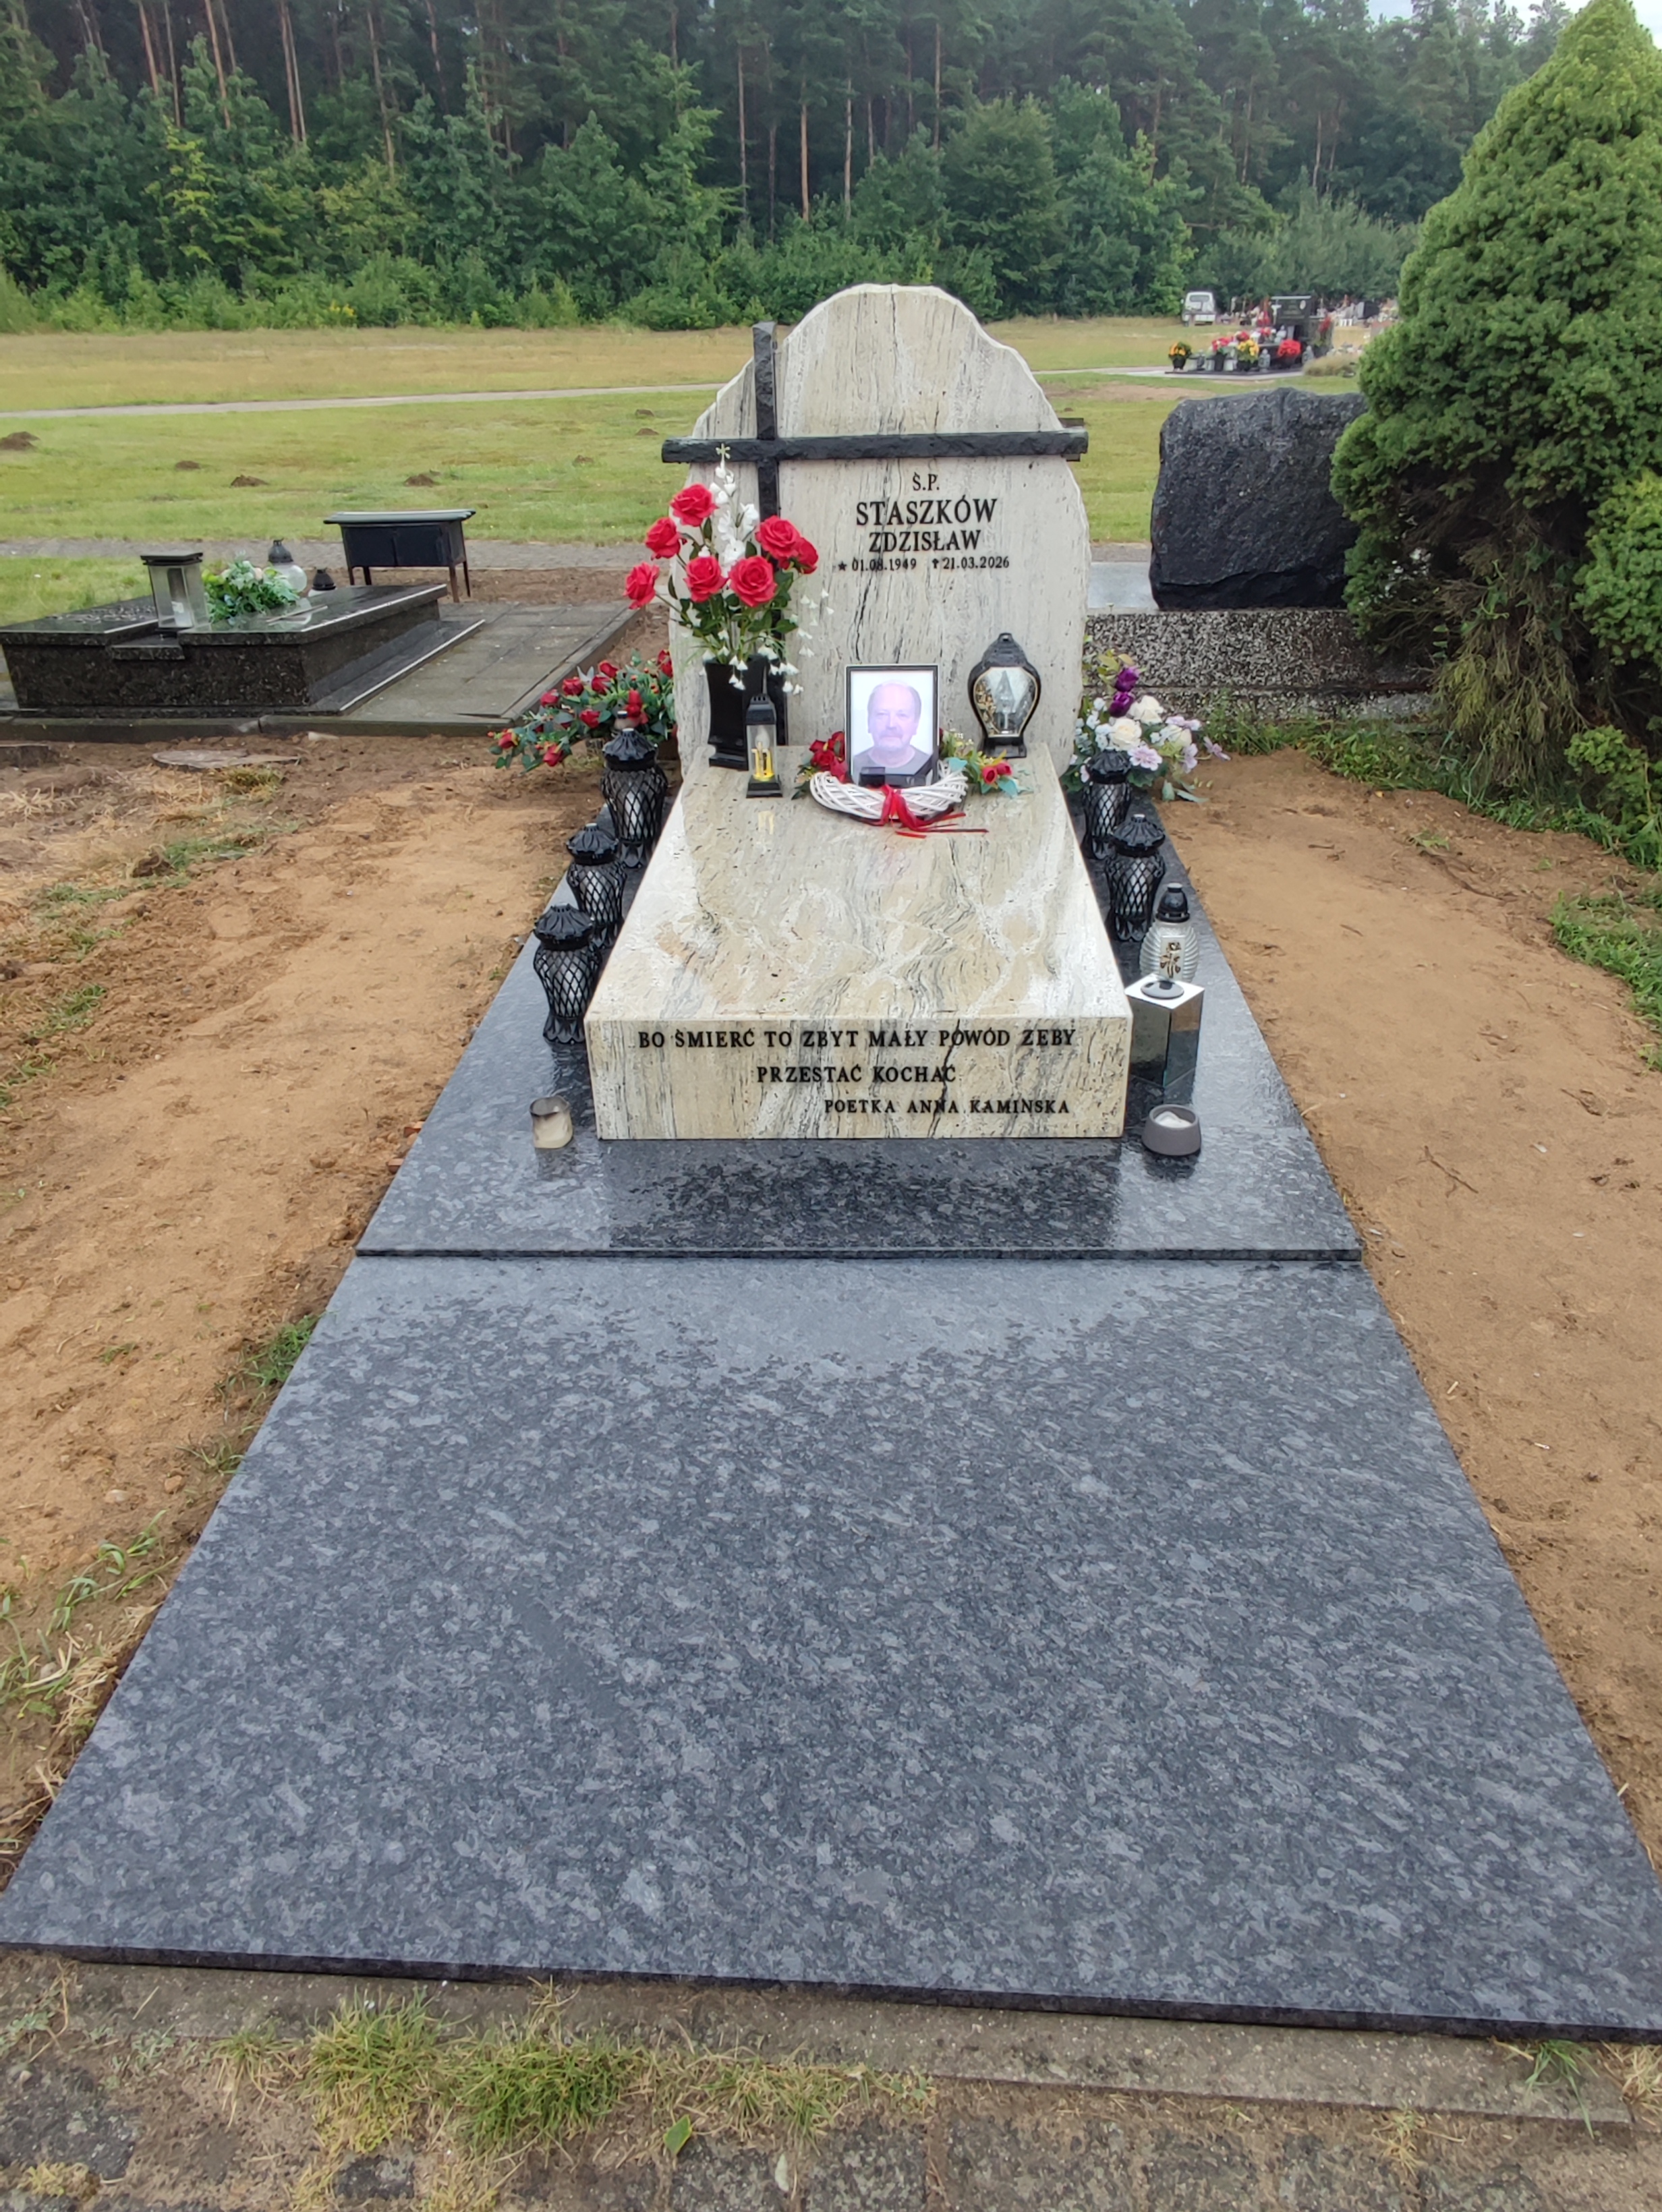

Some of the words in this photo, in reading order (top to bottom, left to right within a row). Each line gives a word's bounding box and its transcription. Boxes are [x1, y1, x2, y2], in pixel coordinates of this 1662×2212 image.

[855, 495, 998, 526] STASZKÓW
[869, 530, 981, 552] ZDZISŁAW
[942, 556, 1010, 569] 21.03.2026
[638, 1031, 665, 1048] BO
[764, 1031, 793, 1047] TO
[803, 1030, 859, 1047] ZBYT
[869, 1030, 929, 1047] MAŁY
[938, 1027, 1010, 1046] POWÓD
[757, 1064, 862, 1083] PRZESTAĆ
[872, 1064, 956, 1082] KOCHAĆ
[824, 1100, 896, 1113] POETKA
[907, 1099, 959, 1113] ANNA
